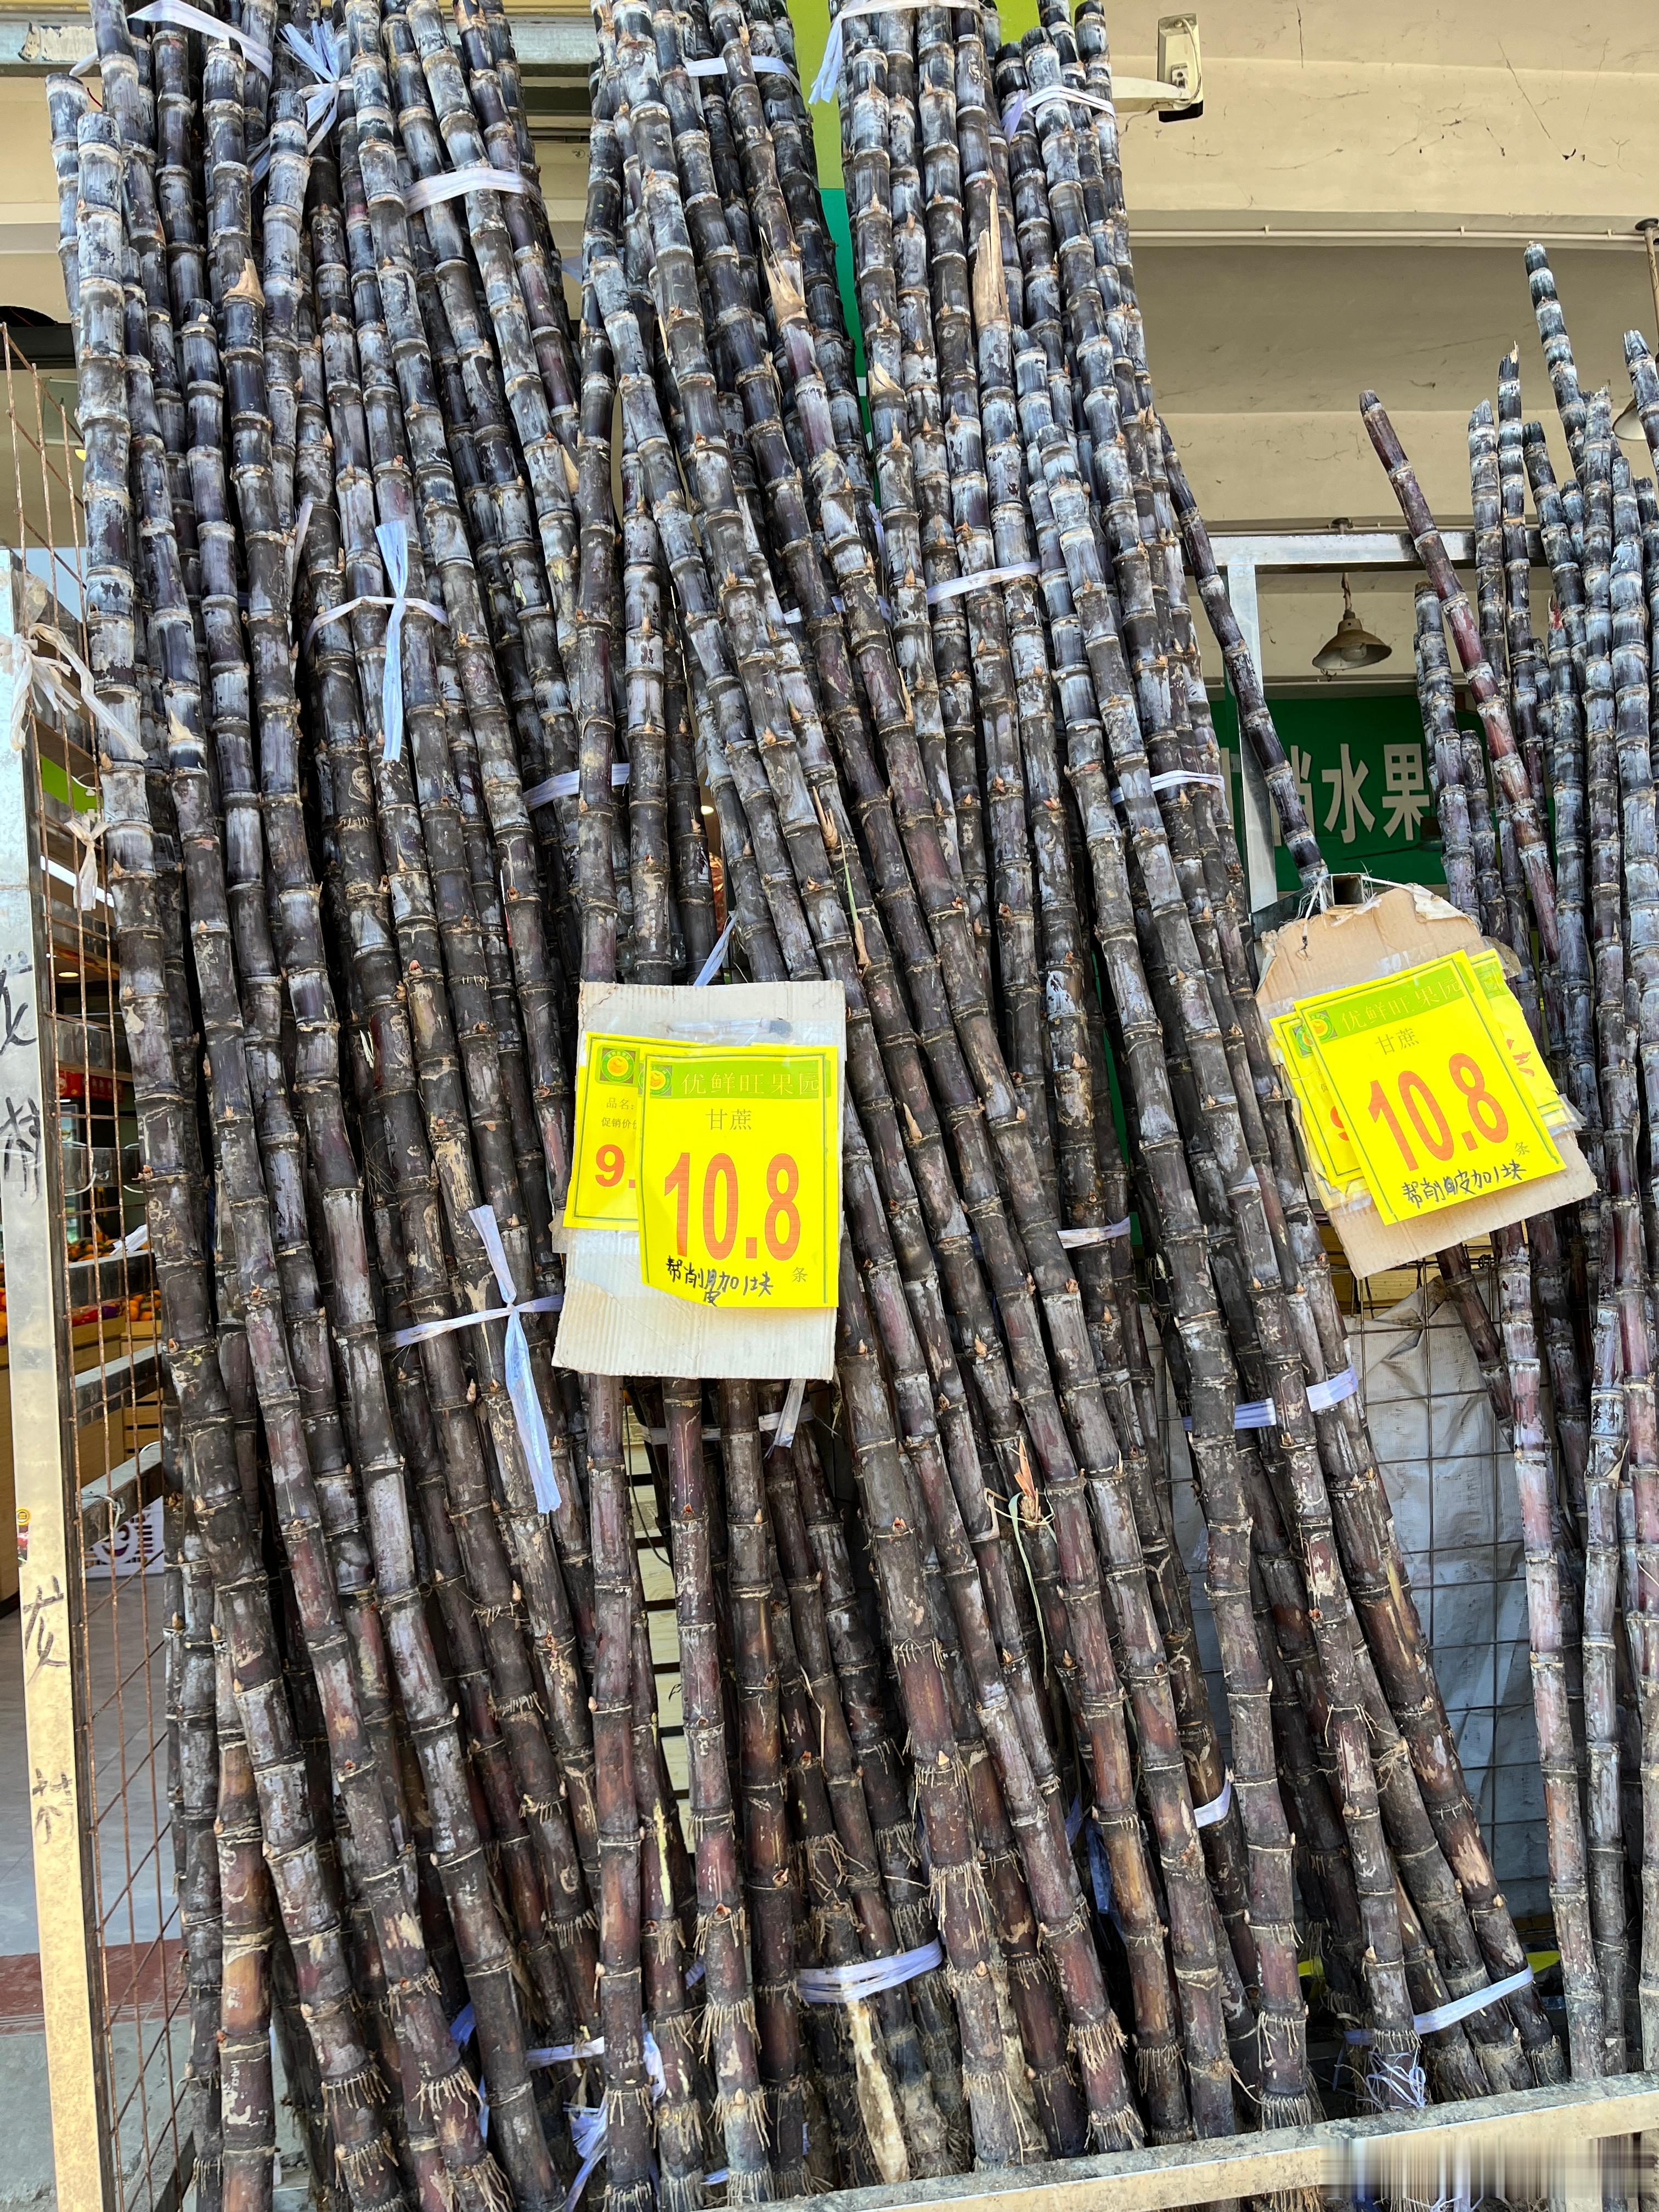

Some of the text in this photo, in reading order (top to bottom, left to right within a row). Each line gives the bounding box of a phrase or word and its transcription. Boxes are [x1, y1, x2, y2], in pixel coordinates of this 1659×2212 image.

[1342, 977, 1462, 1032] 优鲜旺果园
[1375, 1028, 1420, 1055] 甘蔗
[681, 1071, 819, 1096] 优鲜旺果园
[705, 1108, 752, 1131] 甘蔗
[1368, 1053, 1509, 1171] 10.8
[1515, 1141, 1530, 1156] 条
[664, 1152, 801, 1261] 10.8
[792, 1266, 808, 1283] 条
